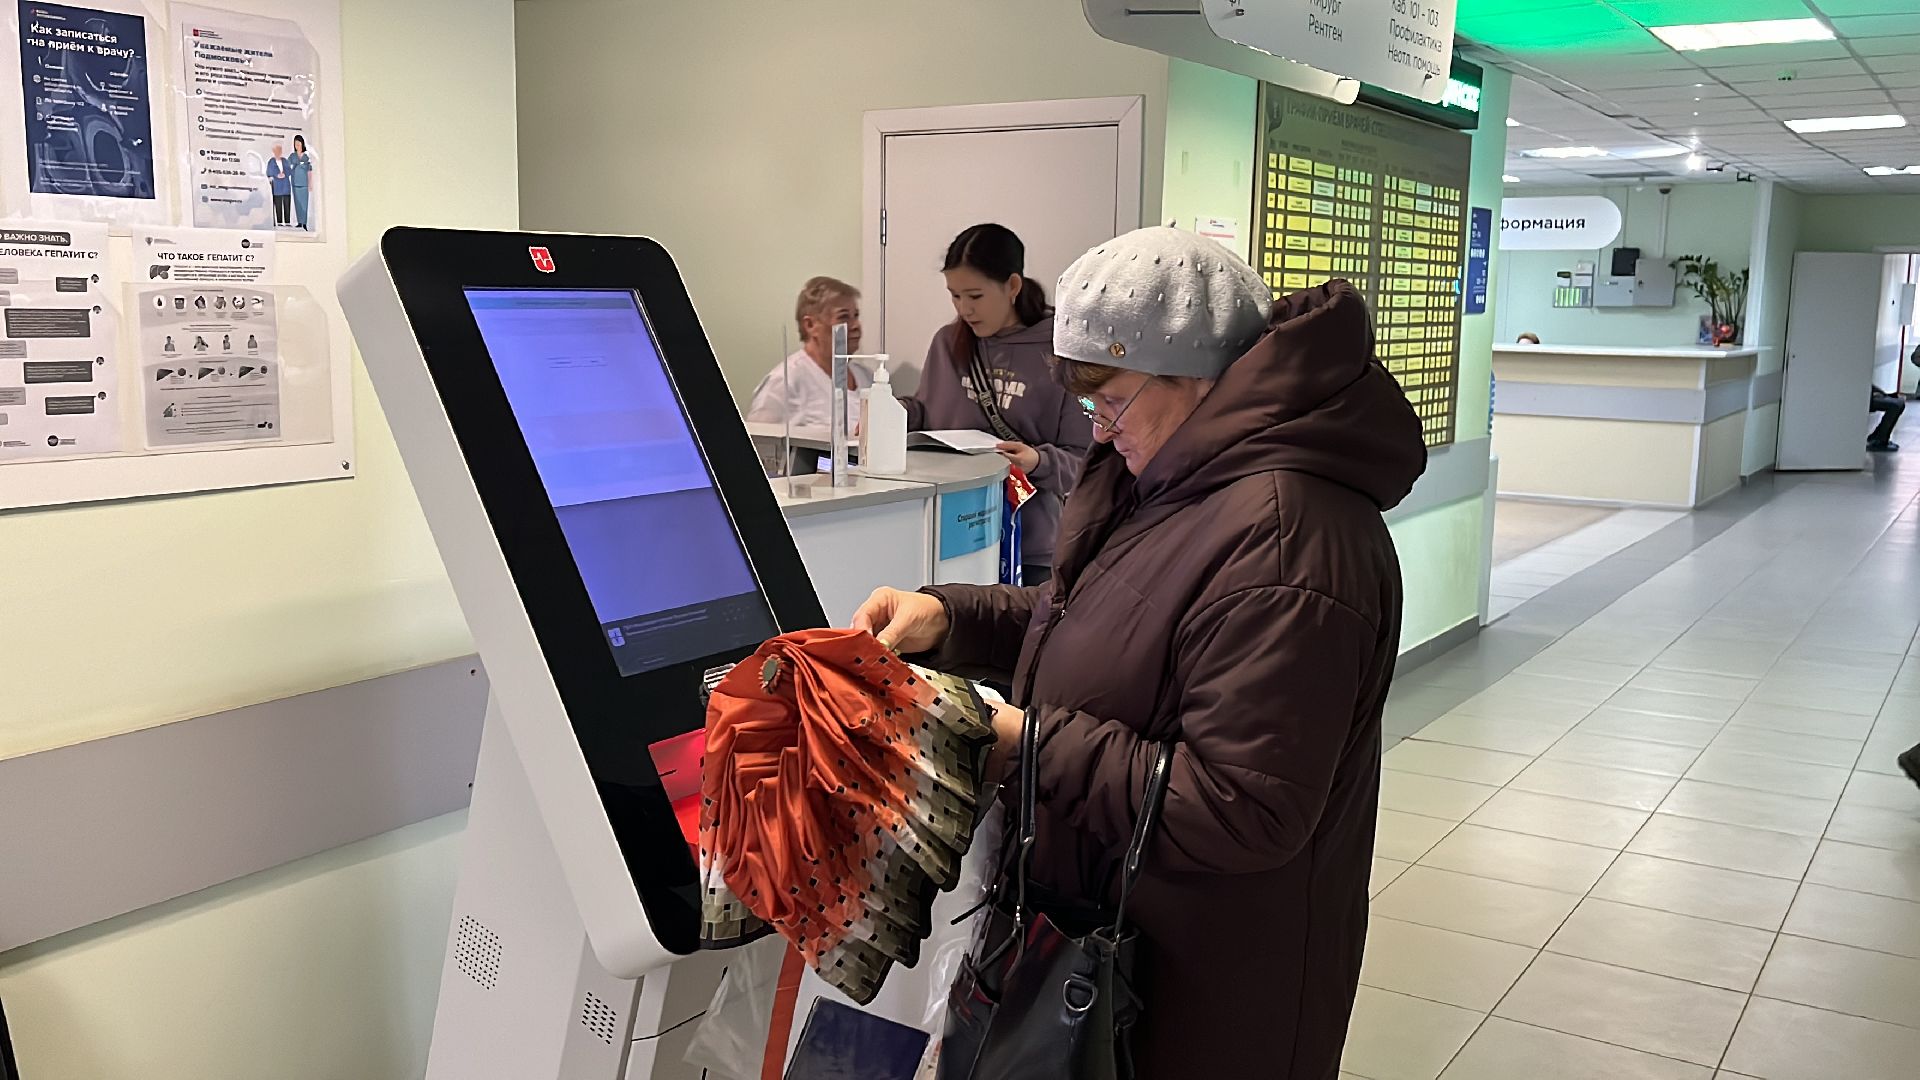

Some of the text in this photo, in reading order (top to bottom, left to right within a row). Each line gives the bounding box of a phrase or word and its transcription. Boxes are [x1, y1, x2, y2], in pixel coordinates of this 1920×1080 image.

[1309, 0, 1341, 15] ирург
[1427, 8, 1439, 27] 103
[31, 23, 117, 43] Как записаться
[1308, 13, 1342, 42] Рентген
[1389, 18, 1442, 53] Профилактика
[31, 39, 45, 47] на
[87, 45, 94, 53] к
[97, 47, 134, 58] врачу?
[1501, 217, 1586, 231] формация
[4, 233, 37, 241] ВАЖНО
[0, 248, 98, 259] ЕЛОВЕКА ГЕПАТИТ С?
[157, 252, 255, 262] ЧТО ТАКОЕ ГЕПАТИТ С?
